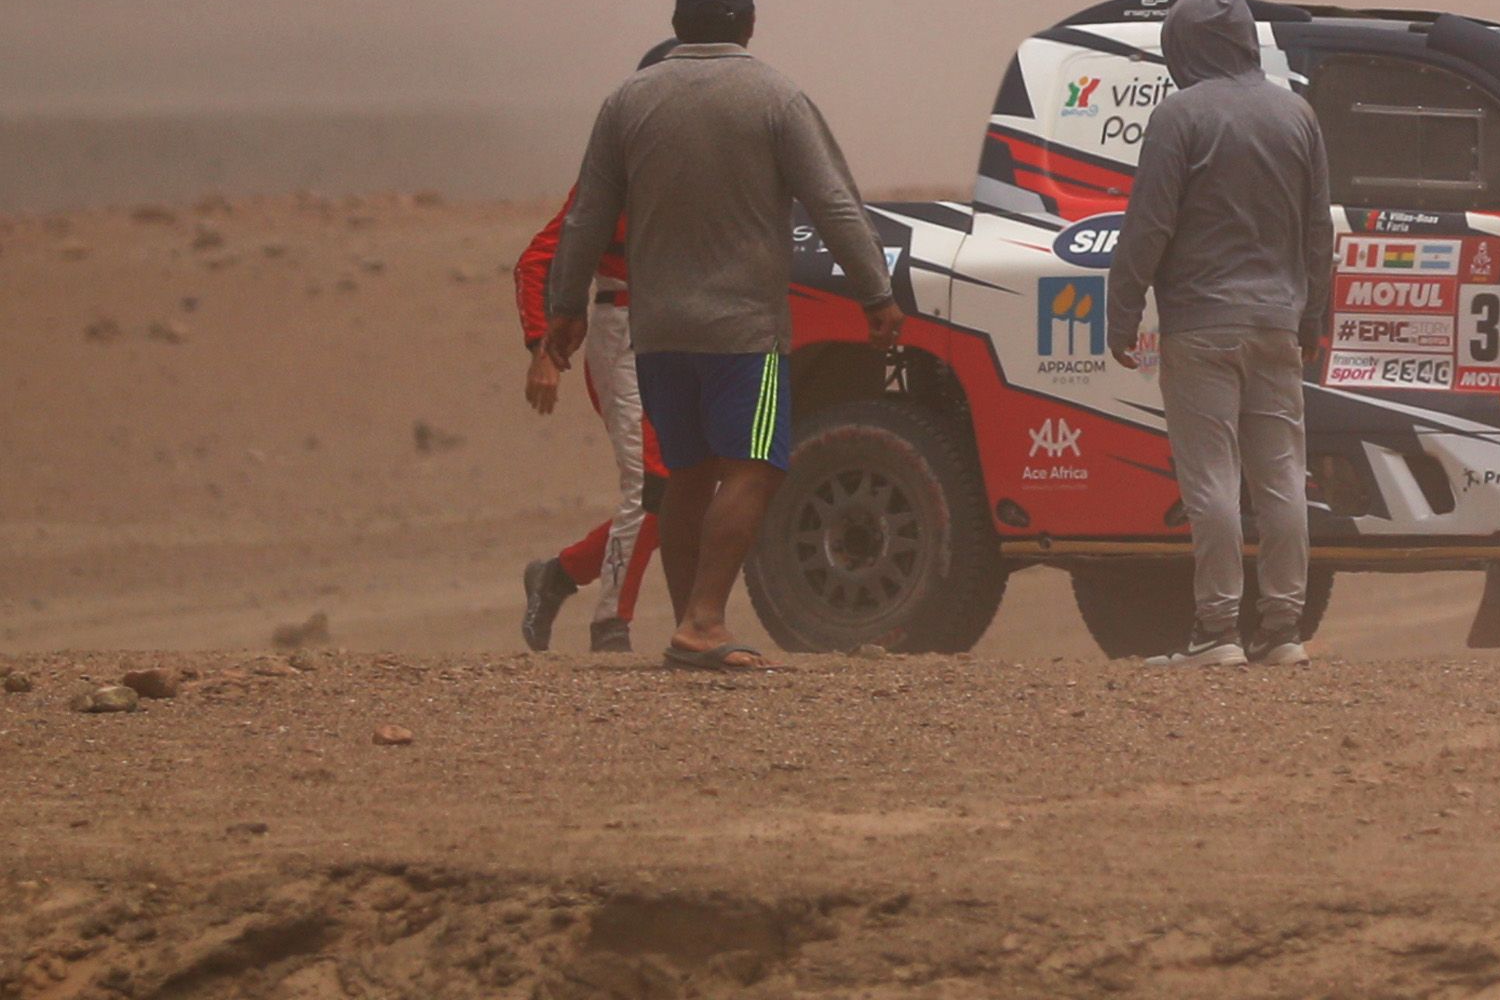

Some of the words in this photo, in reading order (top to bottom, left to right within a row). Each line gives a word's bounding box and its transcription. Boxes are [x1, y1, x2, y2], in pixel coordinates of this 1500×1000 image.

[1112, 76, 1173, 107] visit
[1101, 116, 1143, 145] Po
[1345, 281, 1443, 307] MOTUL
[1038, 361, 1106, 374] APPACDM
[1331, 366, 1376, 384] sport
[1022, 466, 1047, 479] Ace
[1050, 465, 1088, 479] Africa
